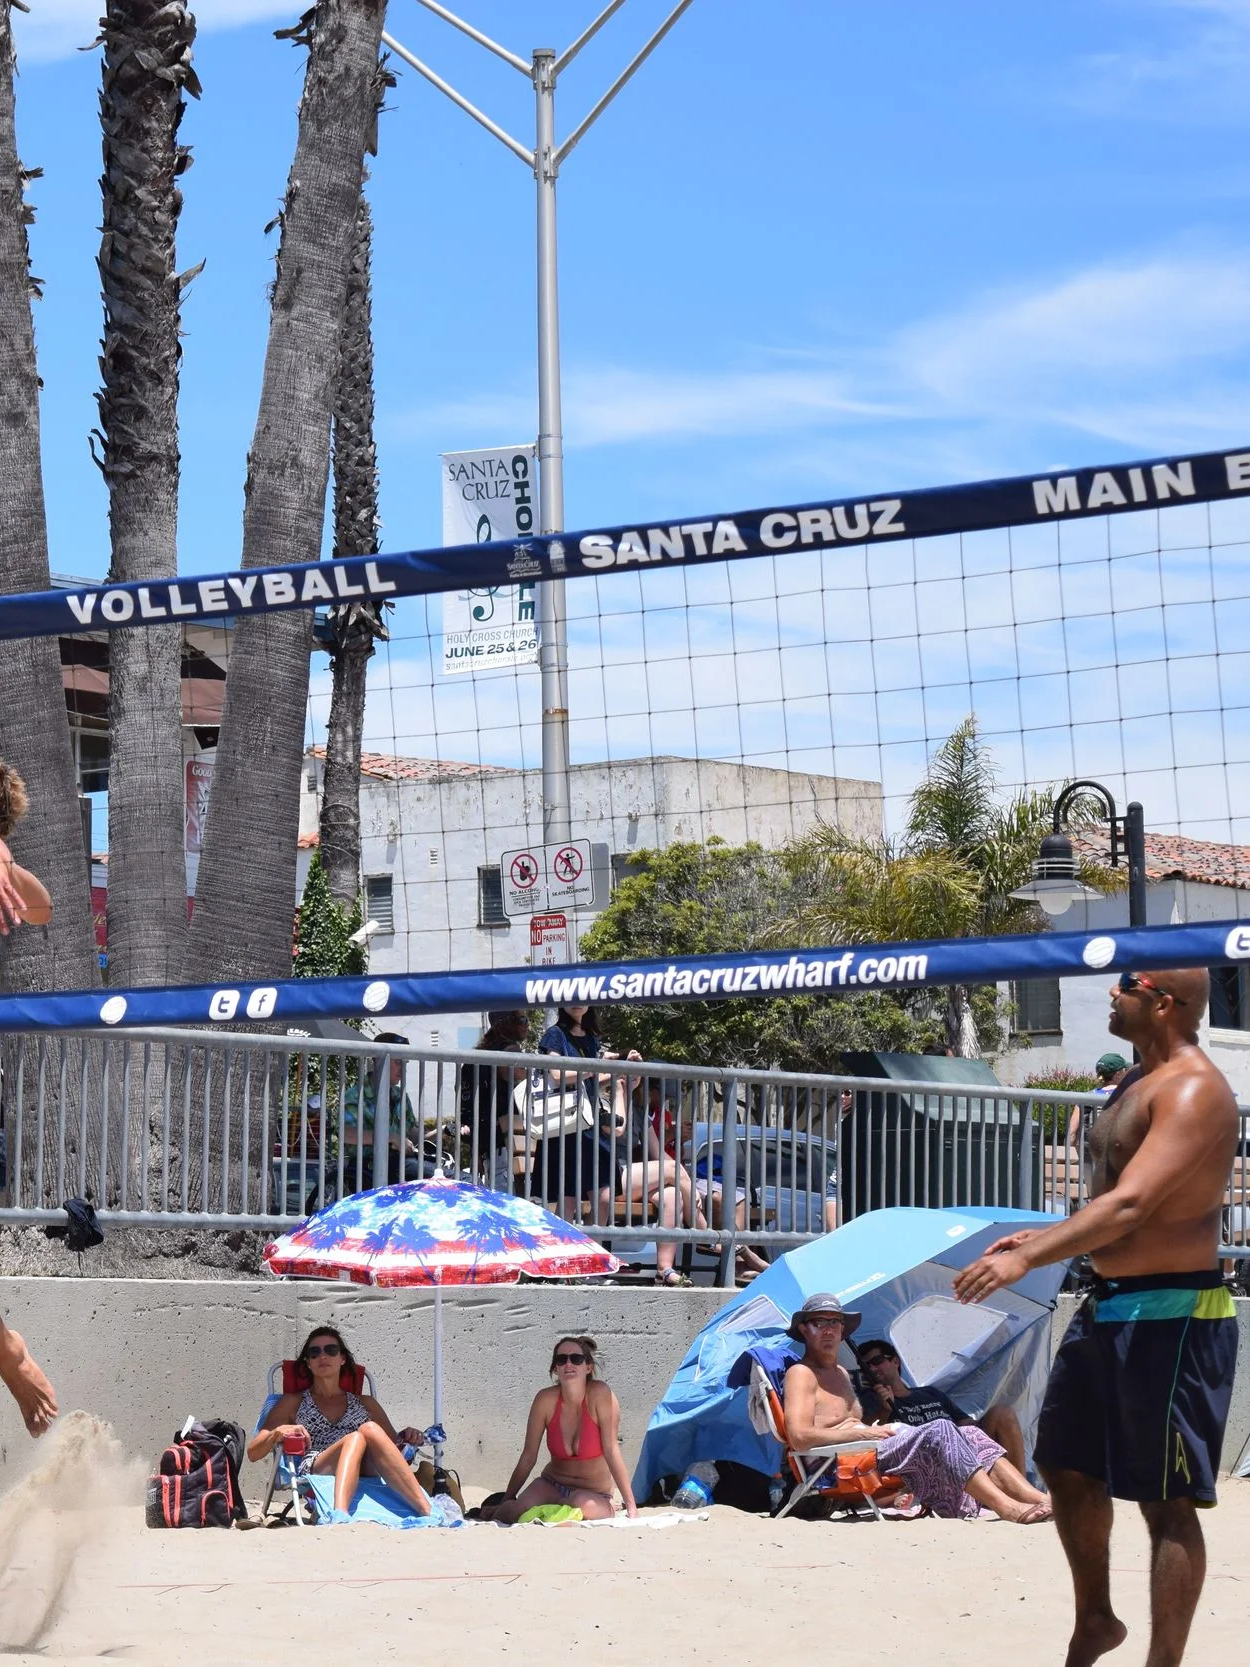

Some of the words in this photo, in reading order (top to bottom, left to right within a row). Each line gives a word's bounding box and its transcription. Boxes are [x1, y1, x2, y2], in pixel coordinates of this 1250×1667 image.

[448, 459, 510, 482] SANTA
[462, 479, 511, 501] CRUZ
[1032, 461, 1196, 514] MAIN
[512, 454, 535, 622] CHOLE
[579, 520, 747, 569] SANTA
[759, 500, 905, 549] CRUZ
[65, 562, 396, 625] VOLLEYBALL
[447, 634, 470, 644] HOLY
[472, 631, 501, 642] CROSS
[503, 627, 537, 639] CHURCH
[445, 645, 484, 658] JUNE
[487, 643, 504, 655] 25
[506, 642, 515, 653] &
[518, 639, 537, 651] 26
[543, 934, 566, 943] PARKING
[545, 946, 552, 955] IN
[526, 952, 928, 1004] www.santacruzwharf.com
